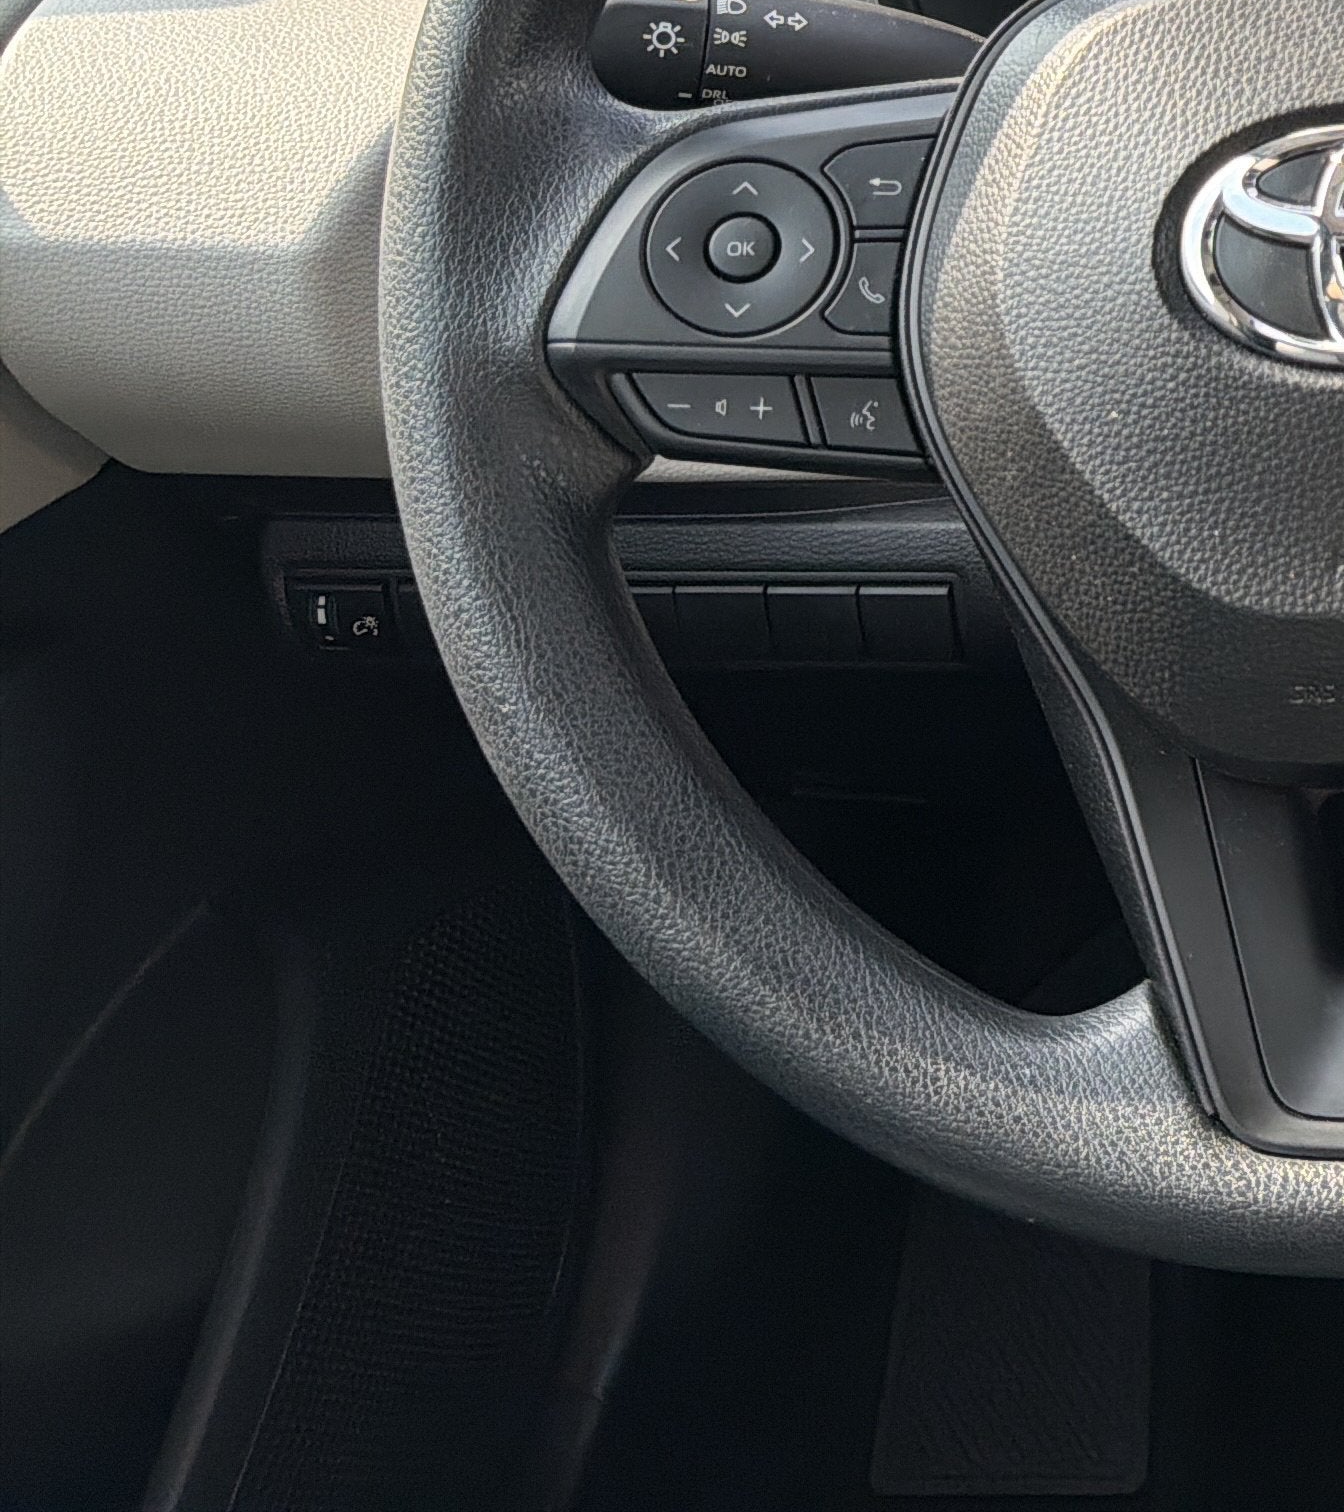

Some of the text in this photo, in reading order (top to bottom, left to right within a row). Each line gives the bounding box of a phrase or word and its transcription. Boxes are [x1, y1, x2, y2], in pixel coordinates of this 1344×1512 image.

[705, 64, 747, 78] AUTO
[701, 88, 729, 101] DRL
[726, 241, 755, 257] OK
